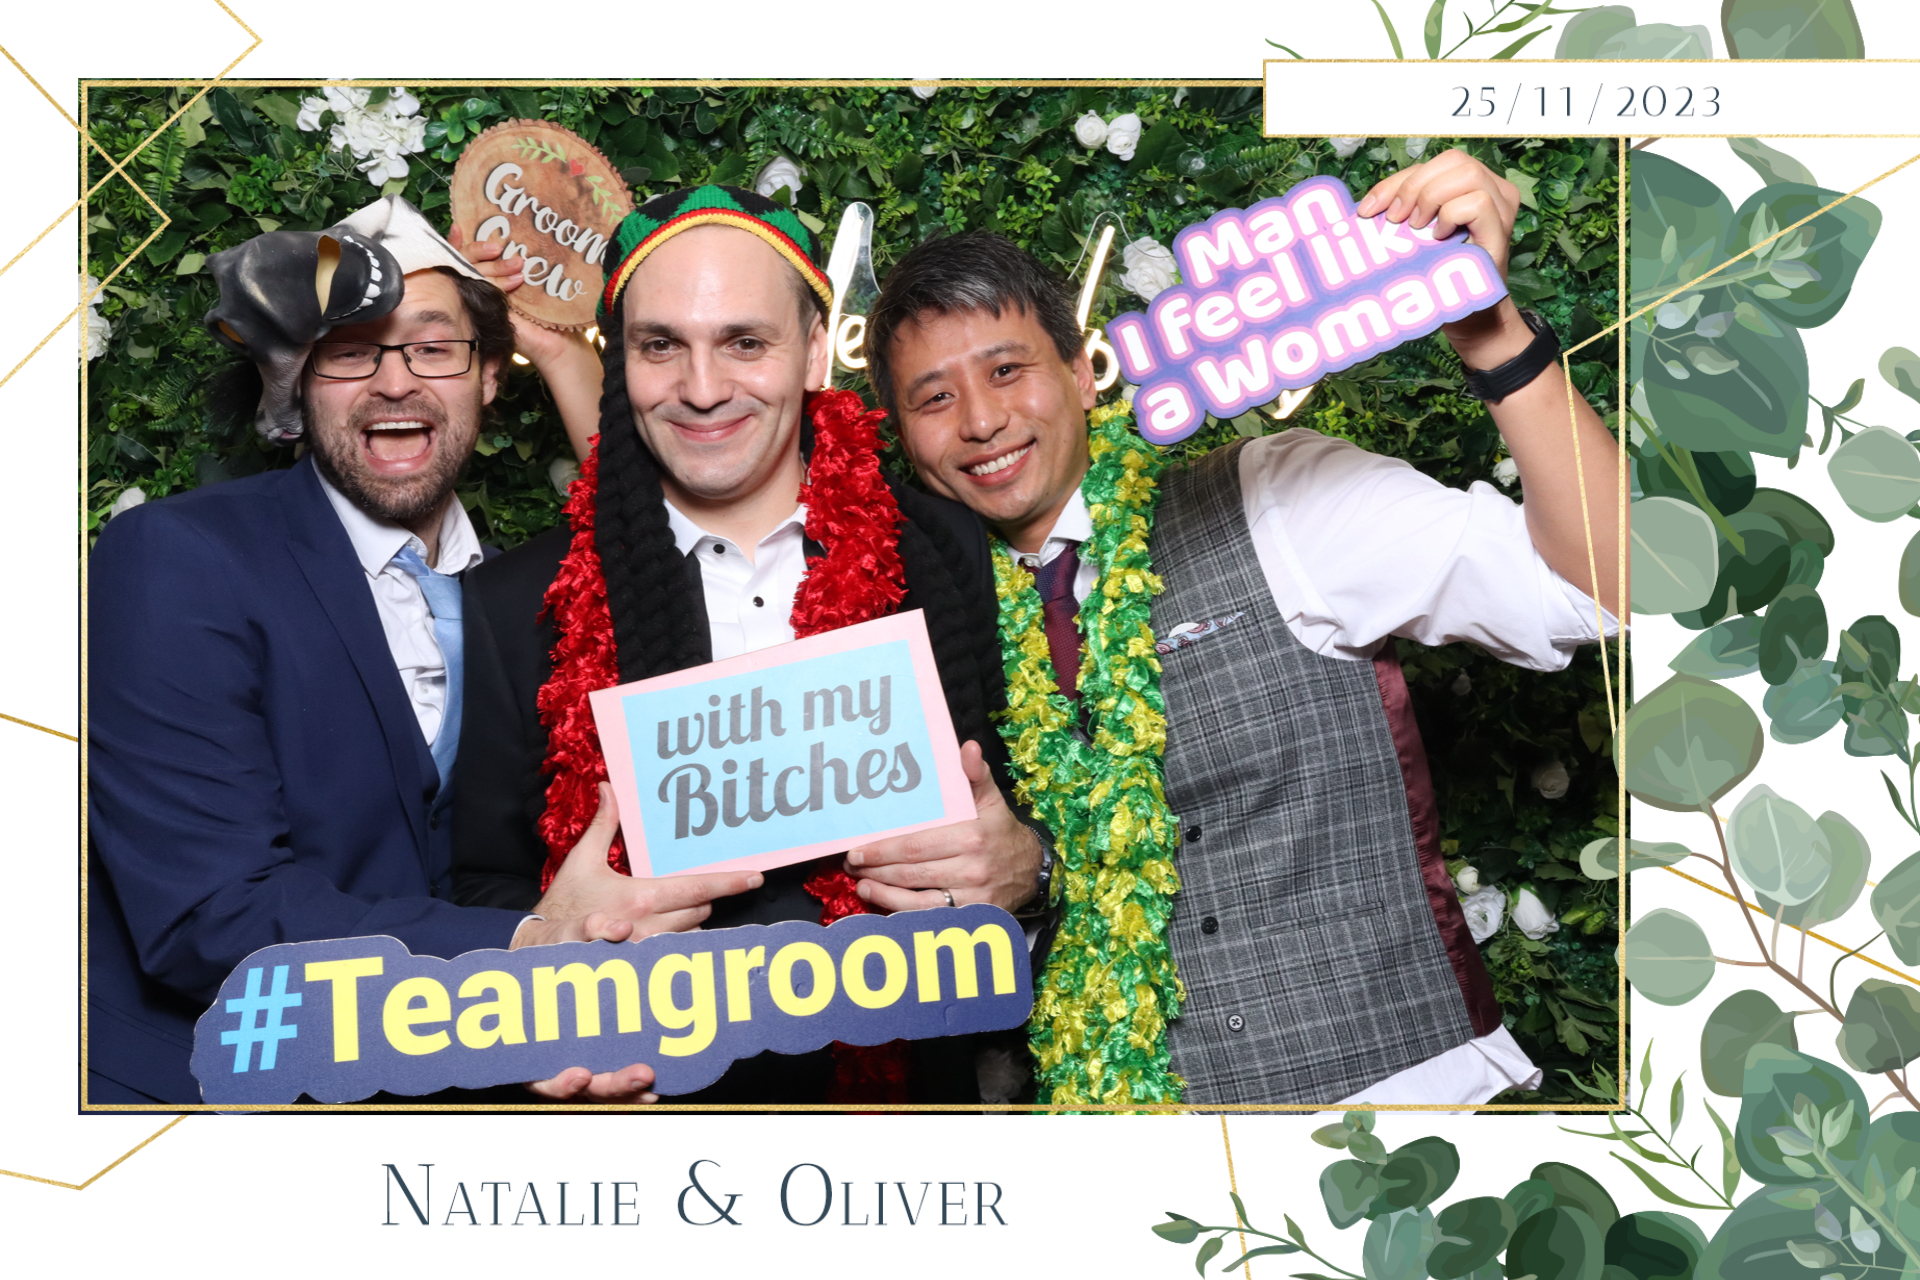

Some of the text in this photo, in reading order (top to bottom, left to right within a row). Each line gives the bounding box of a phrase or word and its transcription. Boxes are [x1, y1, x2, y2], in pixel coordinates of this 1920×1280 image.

[475, 215, 588, 301] Crew
[484, 162, 607, 265] Groom
[1187, 188, 1343, 284] Man
[1121, 321, 1150, 372] I
[1159, 252, 1305, 356] feel
[1146, 387, 1190, 431] a
[657, 674, 892, 760] with my
[657, 741, 922, 840] Bitches
[220, 923, 1016, 1074] #Teamgroom
